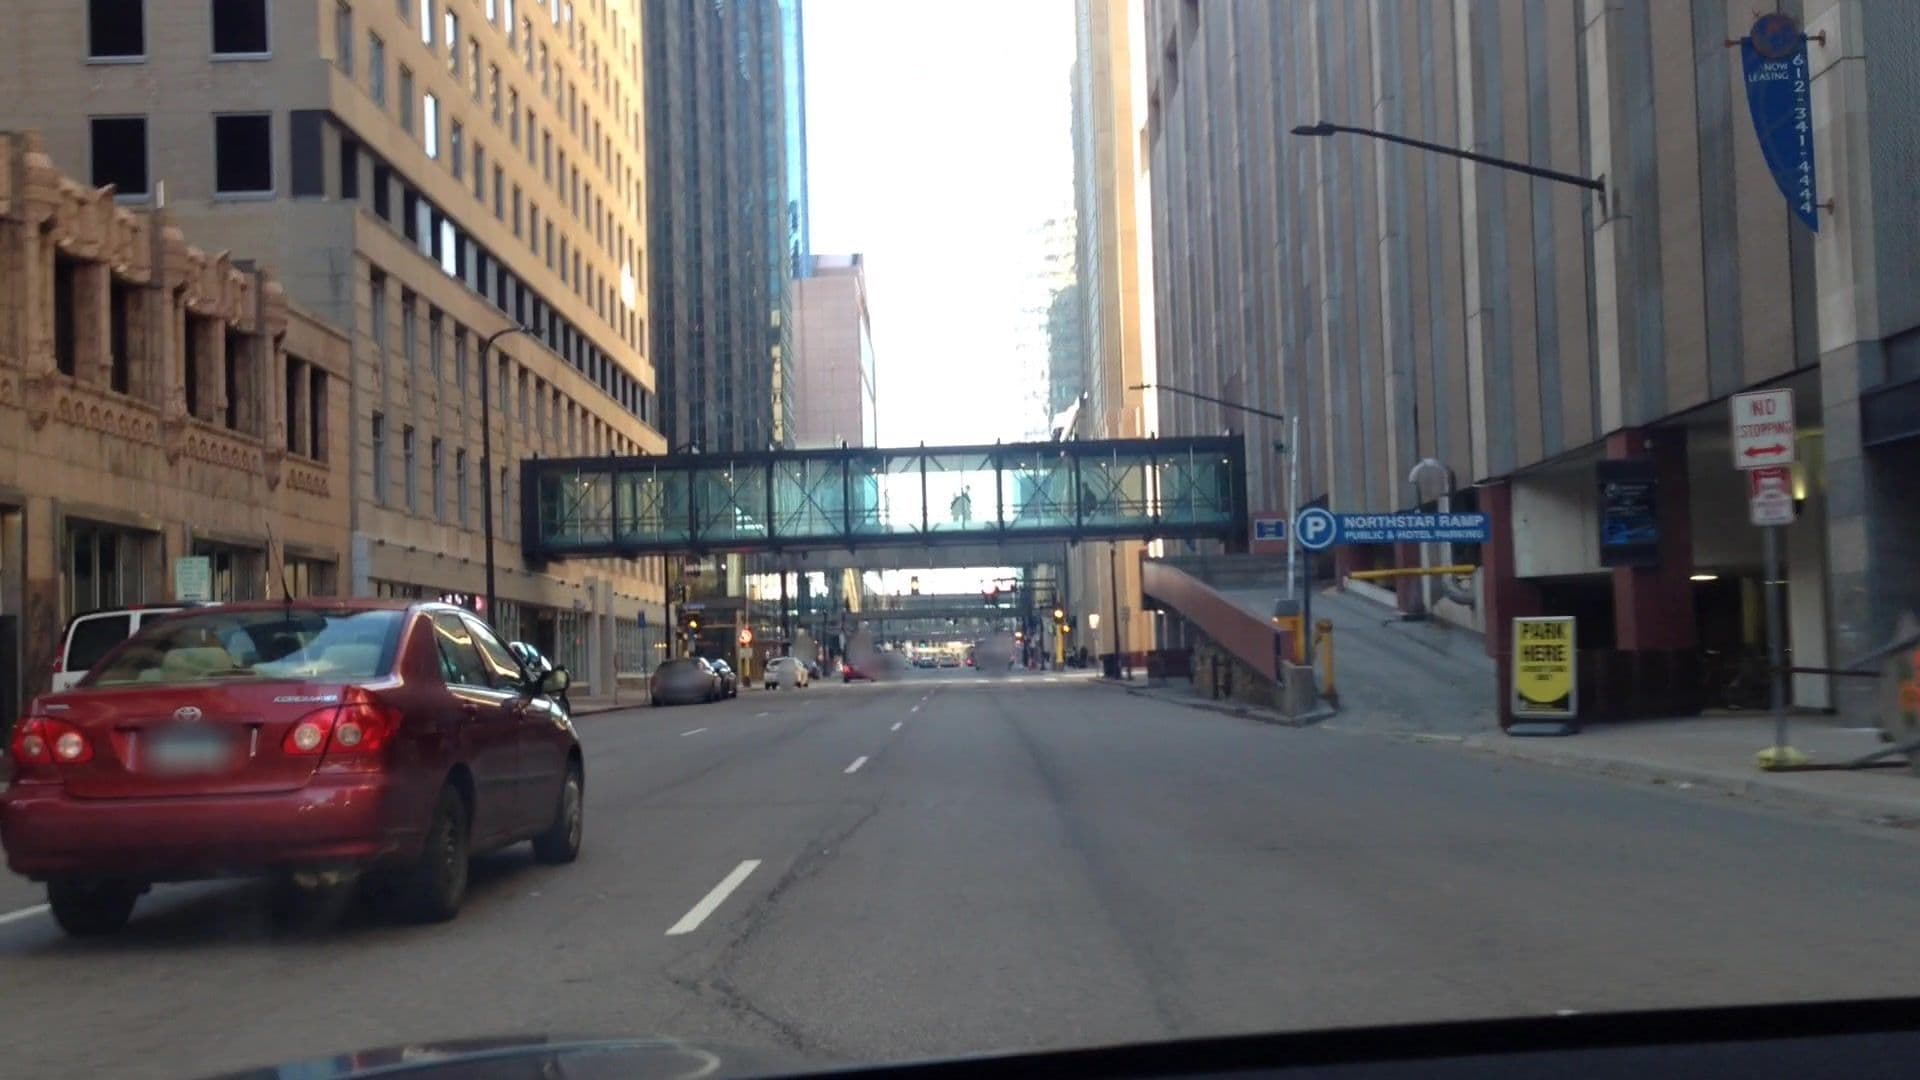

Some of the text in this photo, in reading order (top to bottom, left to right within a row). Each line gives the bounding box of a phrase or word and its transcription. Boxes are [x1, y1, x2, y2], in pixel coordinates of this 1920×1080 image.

[1764, 63, 1788, 71] NOW
[1748, 71, 1789, 82] LEASING
[1751, 398, 1776, 416] NO
[1344, 515, 1484, 529] NORTHSTAR RAMP
[1345, 530, 1384, 540] PUBLIC
[1397, 529, 1431, 540] HOTEL
[1522, 622, 1564, 640] PARK
[1523, 643, 1567, 662] HERE
